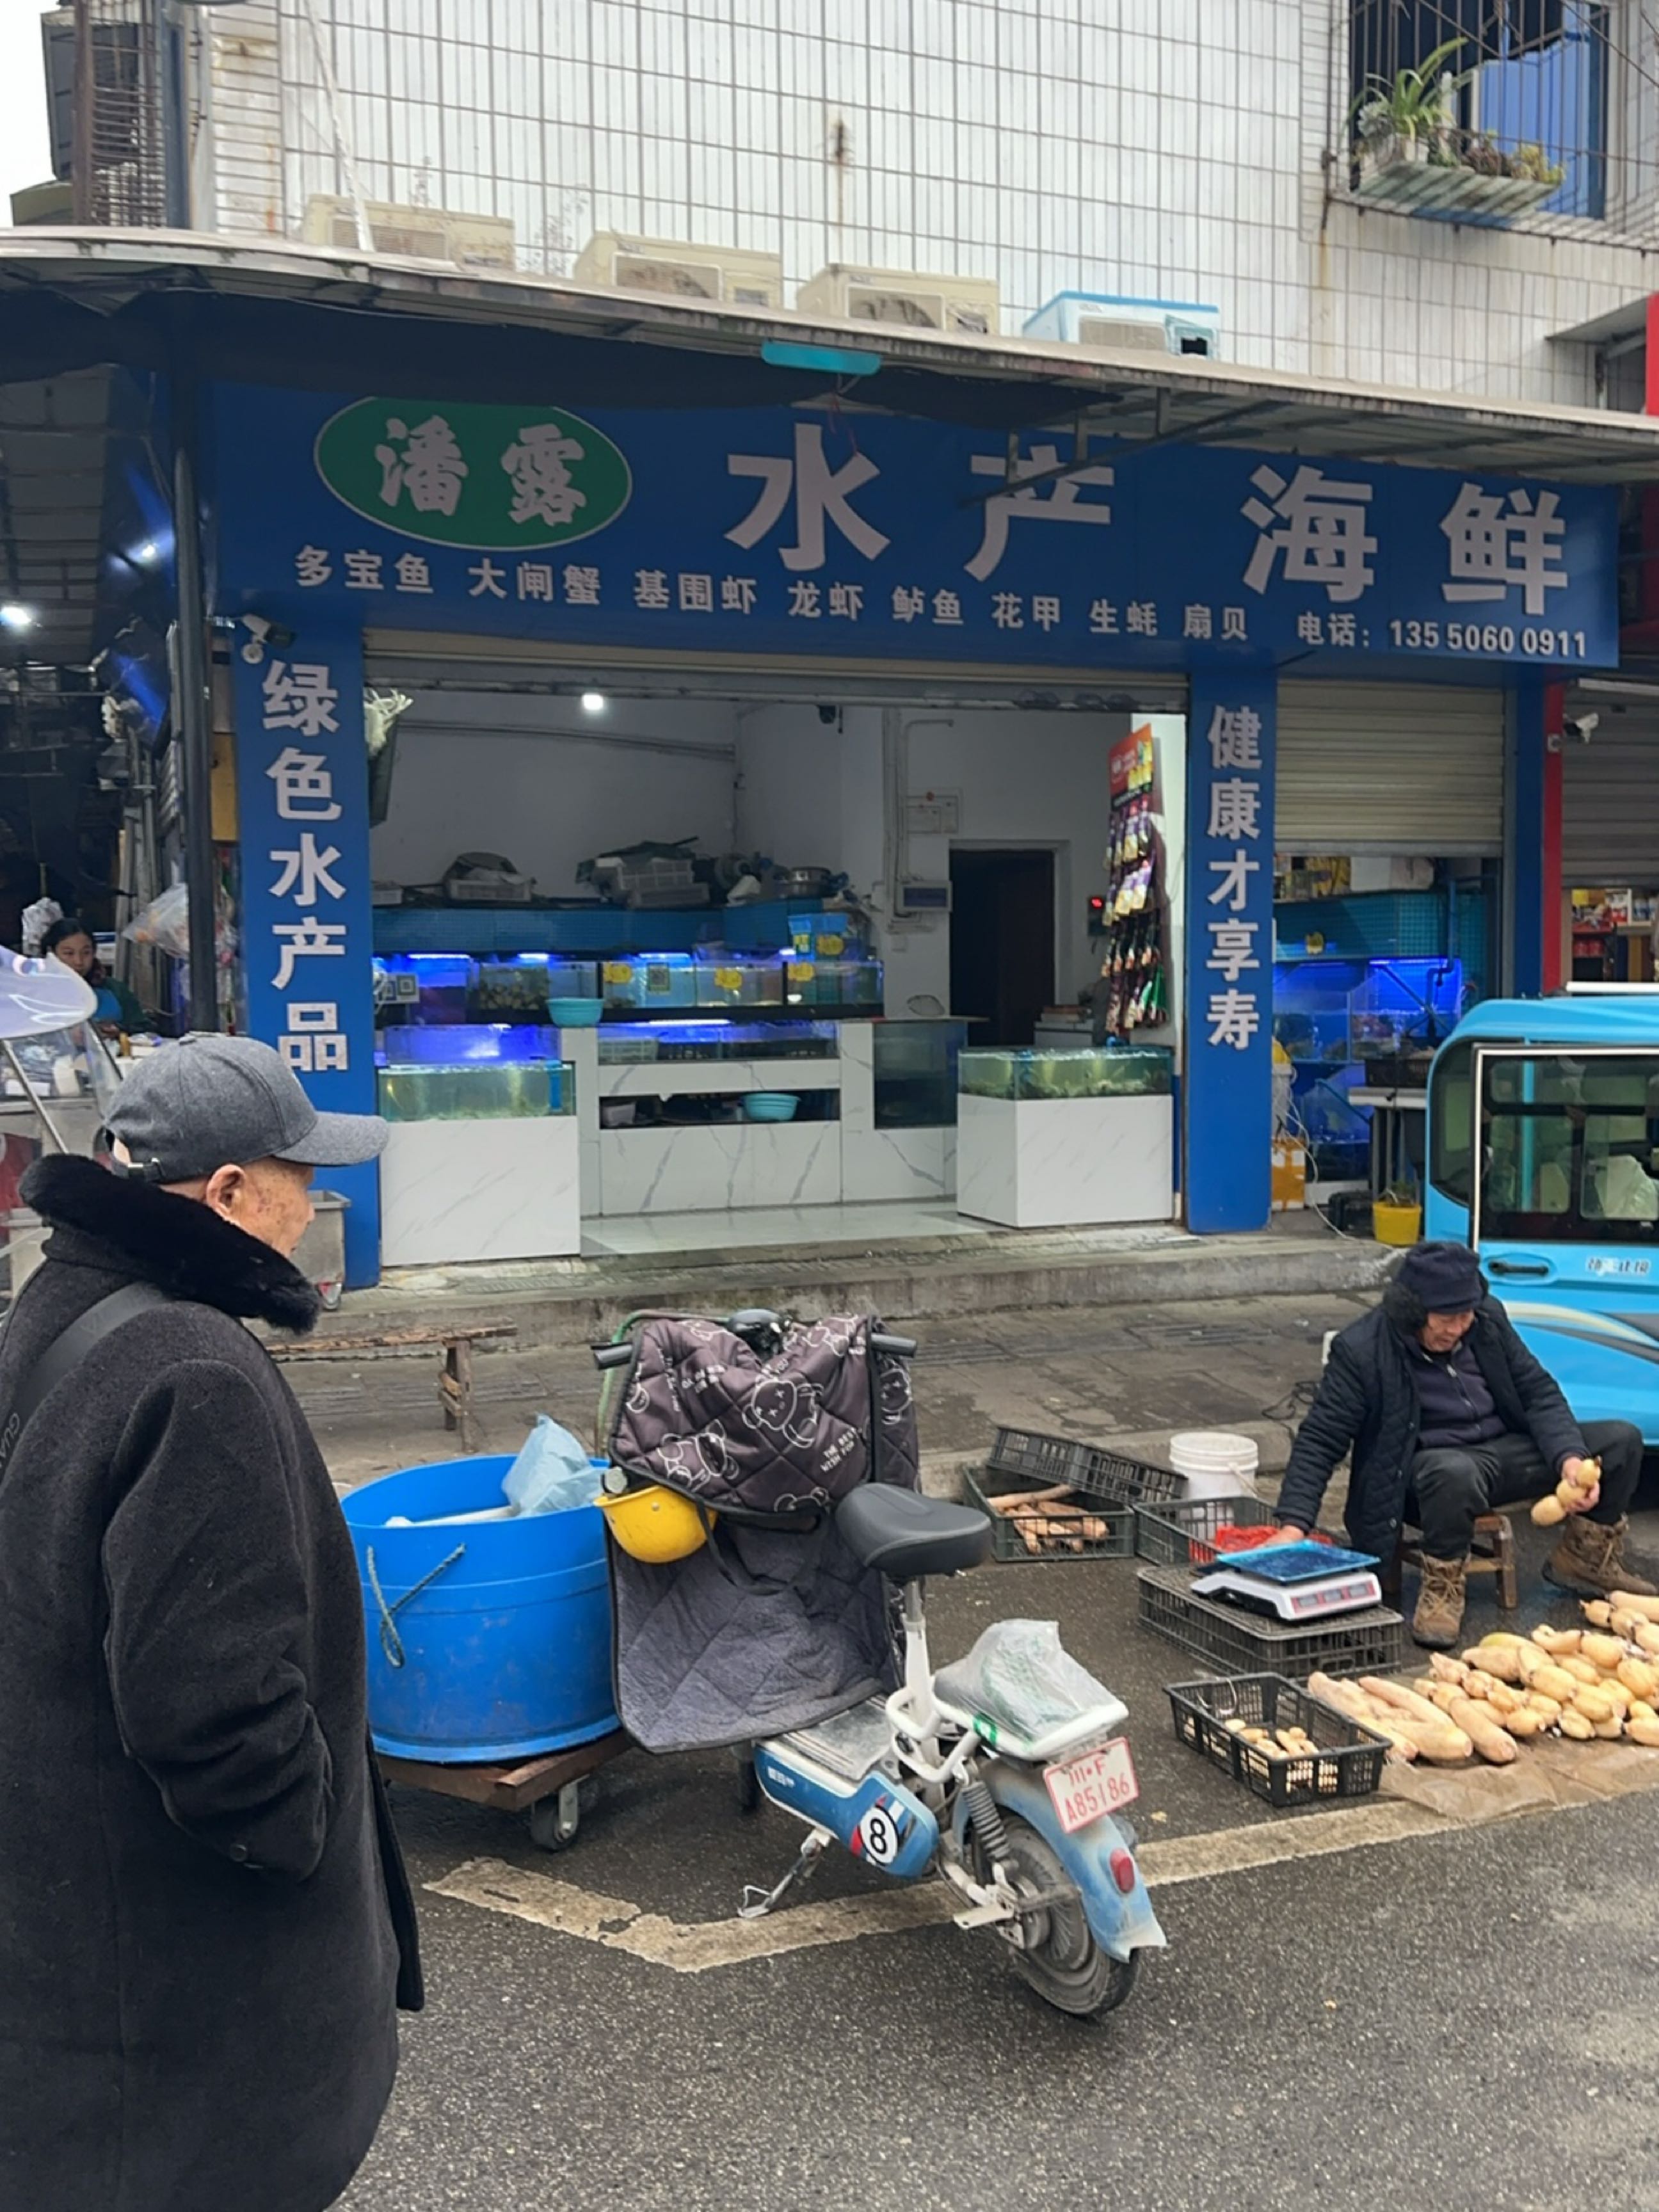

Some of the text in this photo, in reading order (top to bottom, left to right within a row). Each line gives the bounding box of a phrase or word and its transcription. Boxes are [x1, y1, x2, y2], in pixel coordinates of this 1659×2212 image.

[374, 414, 586, 527] 潘露
[294, 544, 1247, 641] 多宝鱼 大闸蟹 基围虾 龙虾 鲈鱼 花甲 生蚝 扇贝
[262, 660, 348, 1073] 绿色水产品
[1206, 704, 1263, 1052] 健康才享寿
[870, 1817, 887, 1855] 8
[1064, 1772, 1130, 1823] A85186
